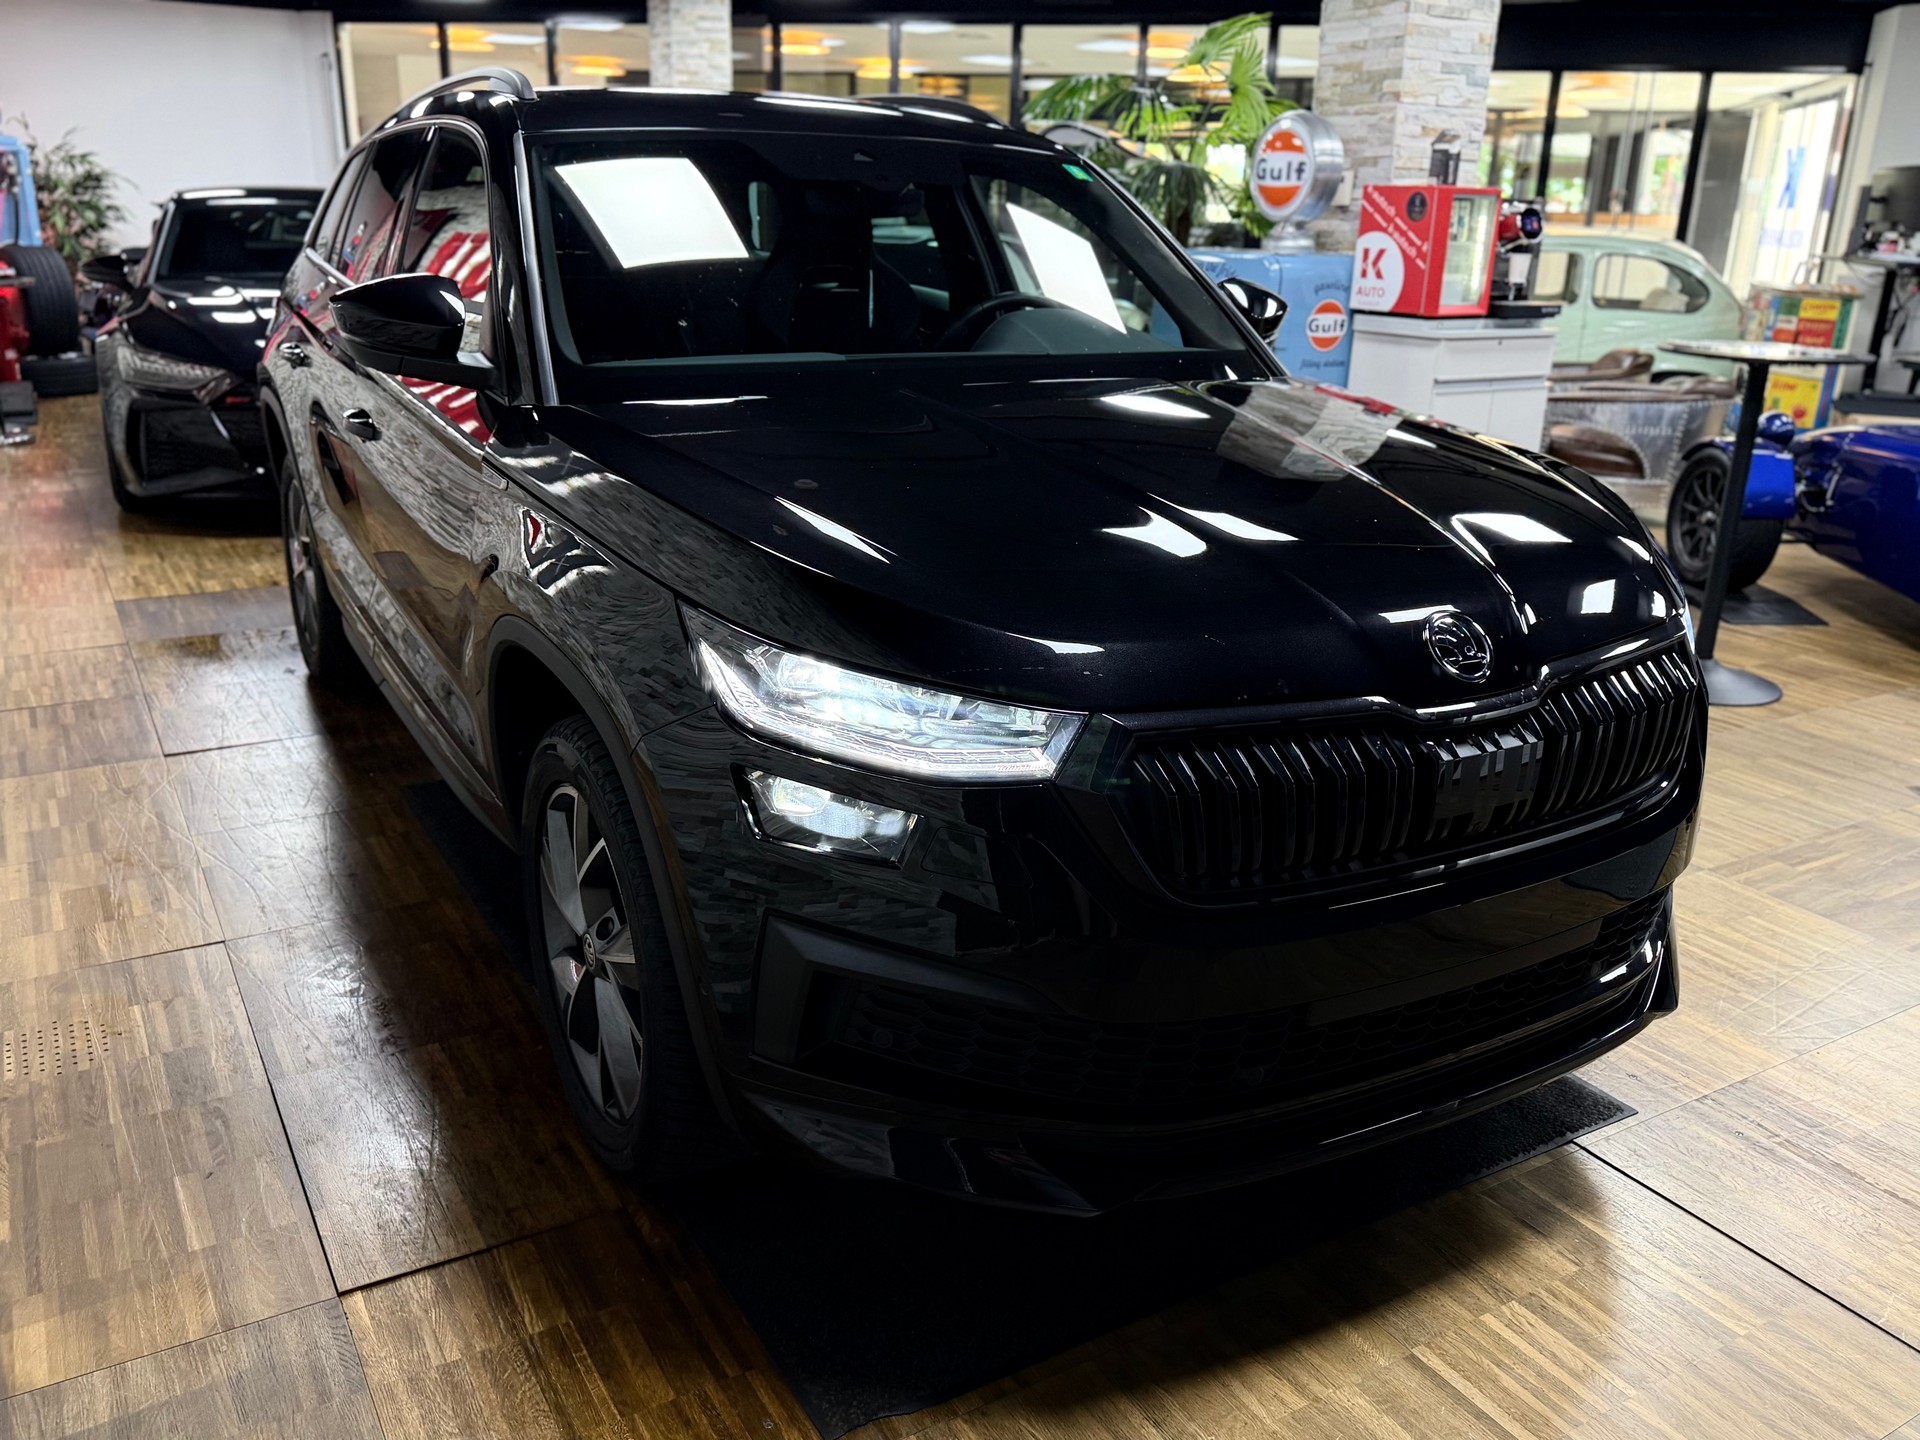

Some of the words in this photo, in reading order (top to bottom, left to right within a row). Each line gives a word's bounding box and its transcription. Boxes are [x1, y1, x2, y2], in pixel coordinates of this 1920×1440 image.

[1256, 158, 1306, 181] Gulf
[1360, 248, 1387, 279] K
[1356, 286, 1385, 298] AUTO
[1308, 318, 1346, 333] Gulf
